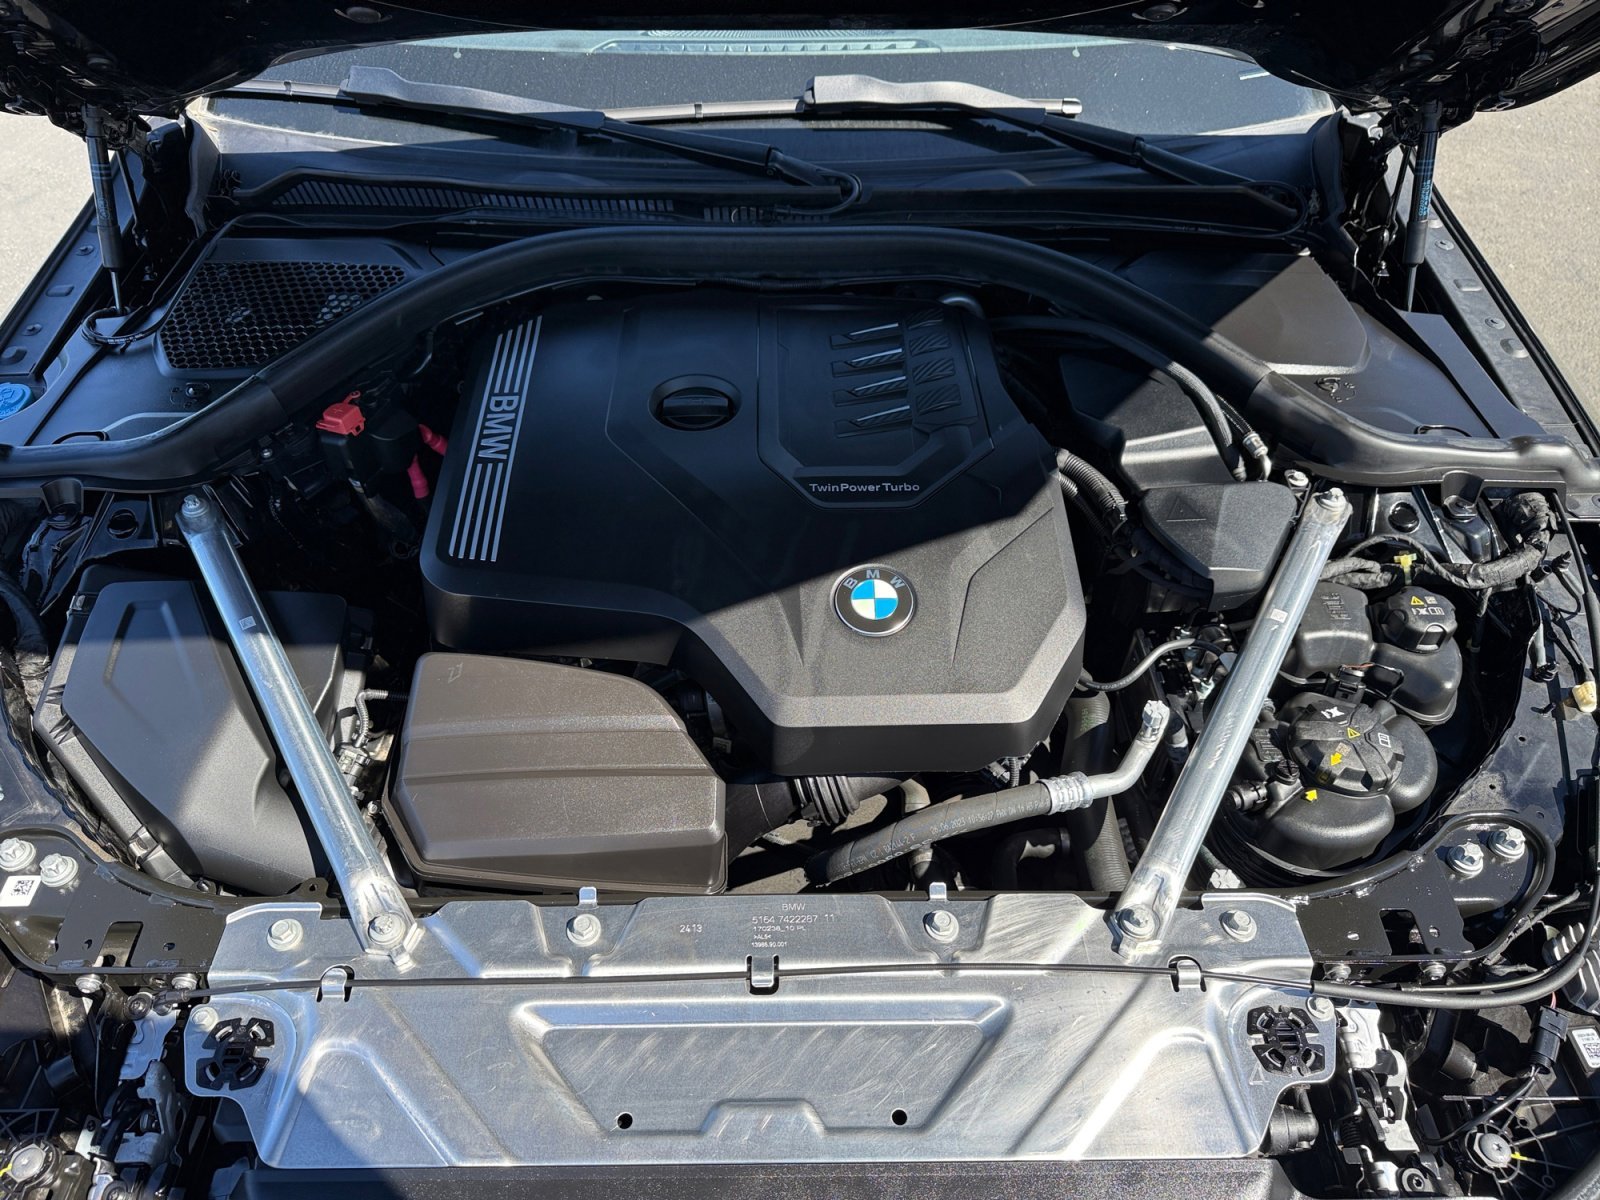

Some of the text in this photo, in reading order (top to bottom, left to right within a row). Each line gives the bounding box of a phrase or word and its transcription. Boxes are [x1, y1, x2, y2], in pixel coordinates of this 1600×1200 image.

[478, 395, 520, 460] BMW
[809, 482, 920, 492] TwinPower Turbo
[842, 569, 906, 589] BMW
[782, 903, 806, 911] BMW
[752, 916, 775, 924] 5164
[680, 924, 703, 933] 2413
